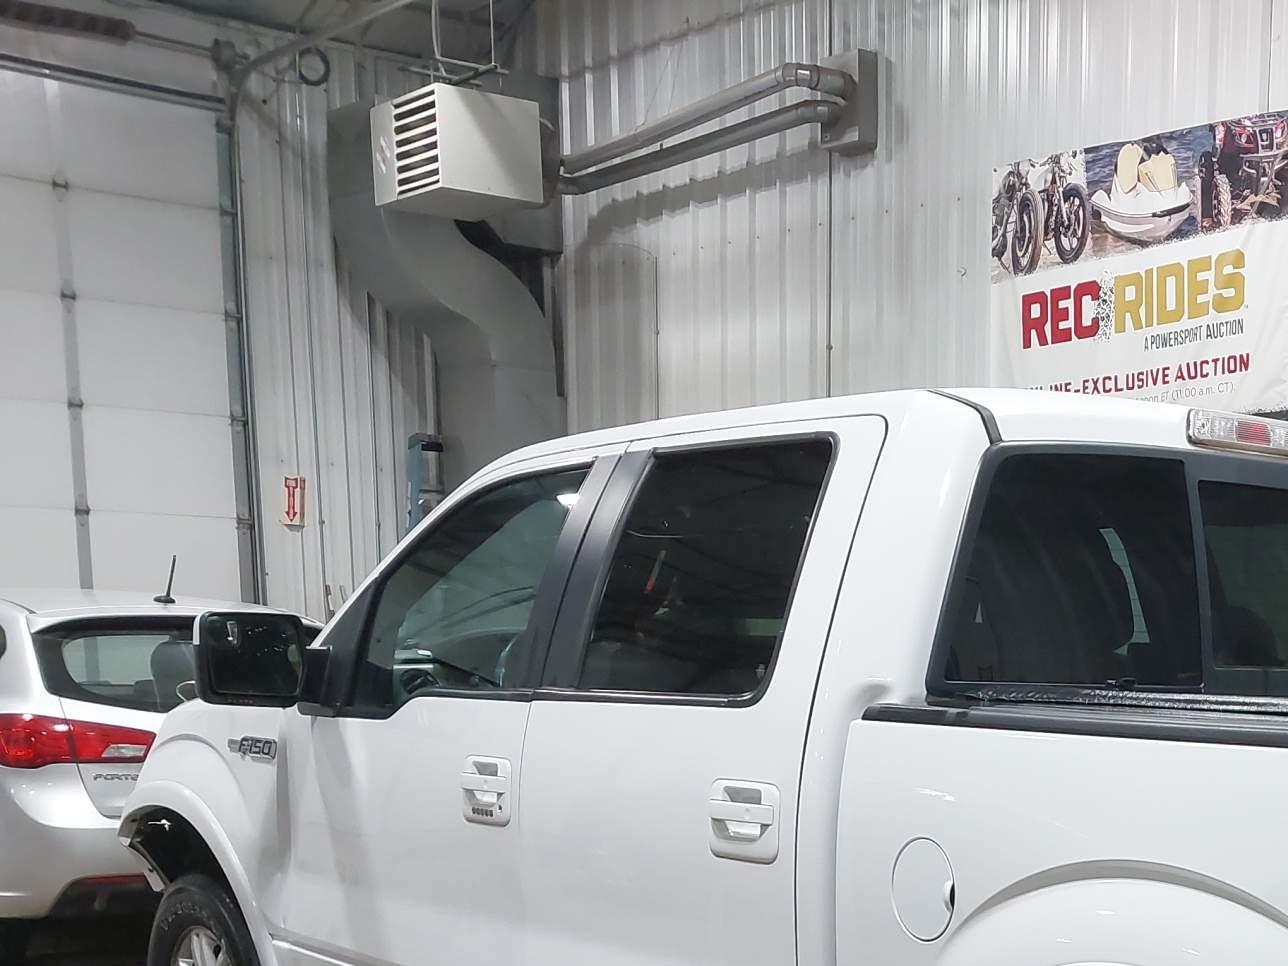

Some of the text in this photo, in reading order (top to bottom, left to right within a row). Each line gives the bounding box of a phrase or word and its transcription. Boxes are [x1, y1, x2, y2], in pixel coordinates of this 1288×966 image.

[1022, 248, 1246, 349] REC RIDES
[1144, 318, 1244, 352] A POWERSPORT AUCTION
[1026, 353, 1250, 394] NE-EXCLUSIVE AUCTION
